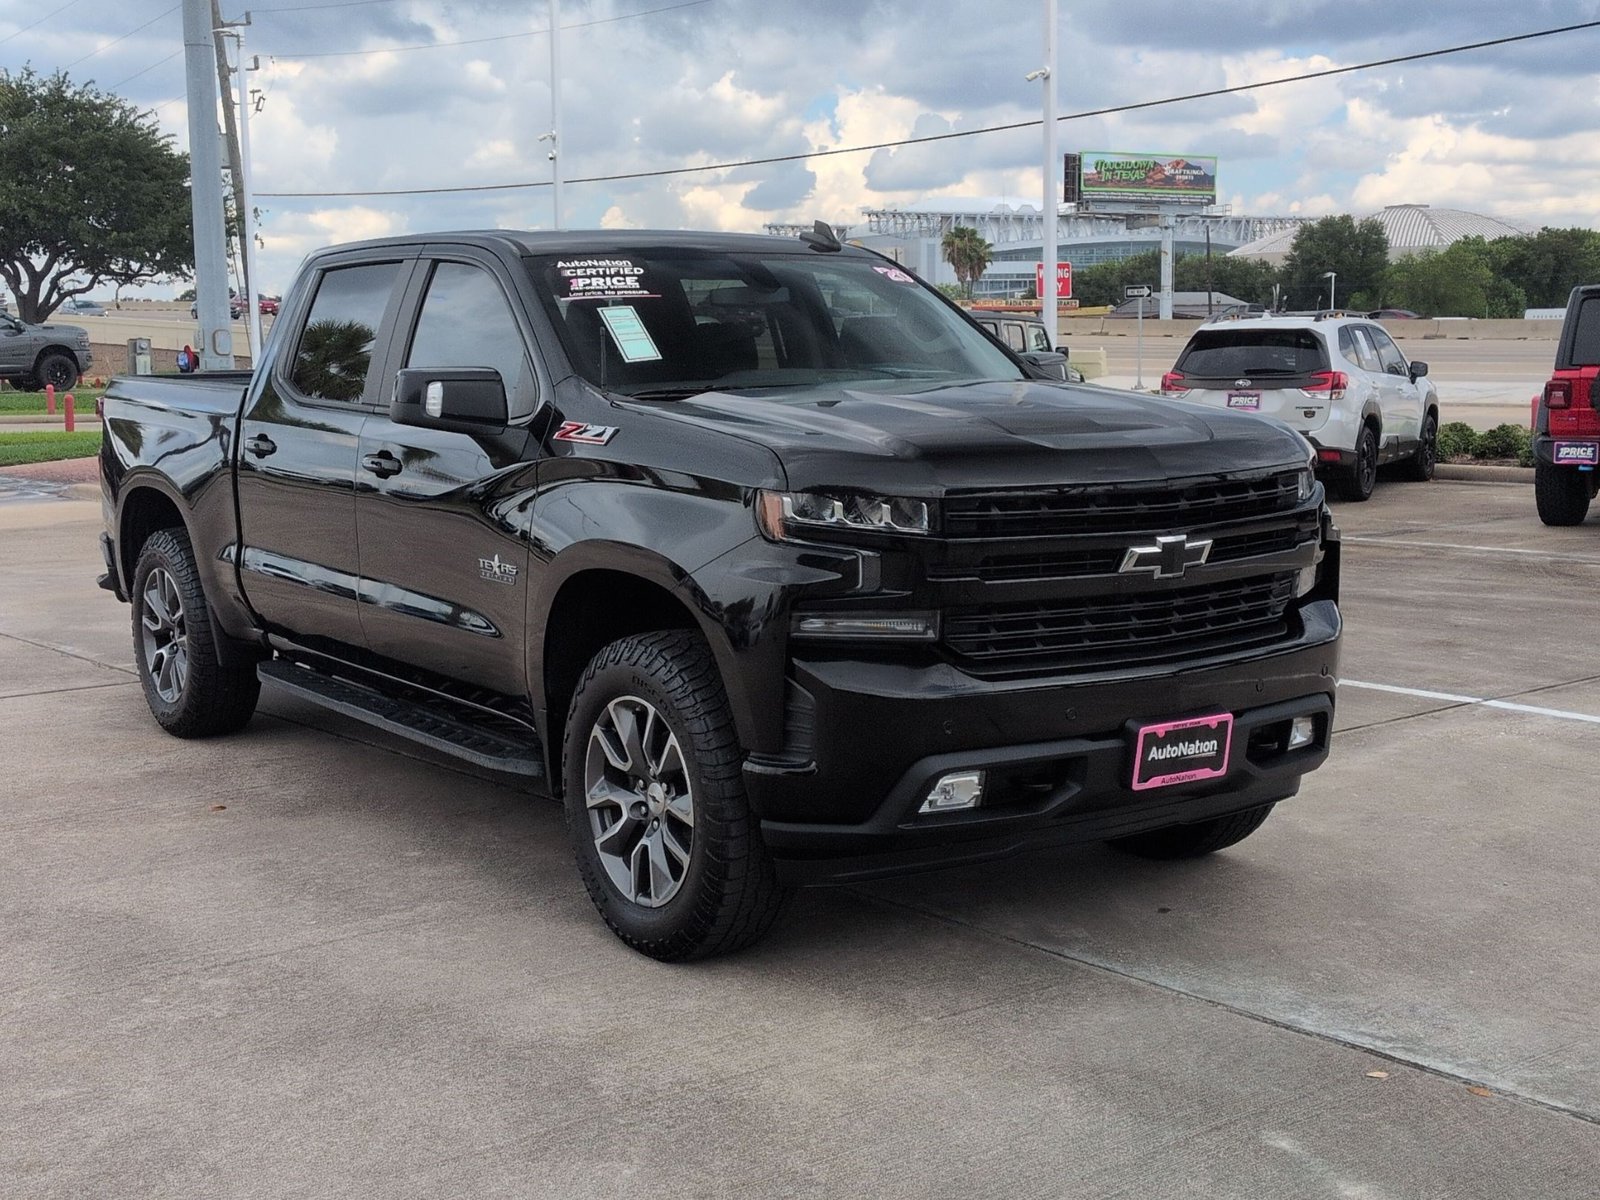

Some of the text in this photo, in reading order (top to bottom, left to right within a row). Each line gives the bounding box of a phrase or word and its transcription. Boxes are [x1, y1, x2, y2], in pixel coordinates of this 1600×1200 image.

[1095, 160, 1155, 171] TOUCHDOWN
[1113, 170, 1146, 181] TEXAS
[556, 259, 633, 268] AutoNation
[566, 267, 645, 277] CERTIFIED
[1039, 268, 1070, 279] WNG
[553, 419, 620, 446] Z71
[478, 554, 517, 576] TEXAS
[1147, 739, 1218, 761] AutoNation
[1161, 774, 1197, 784] AutoNation
